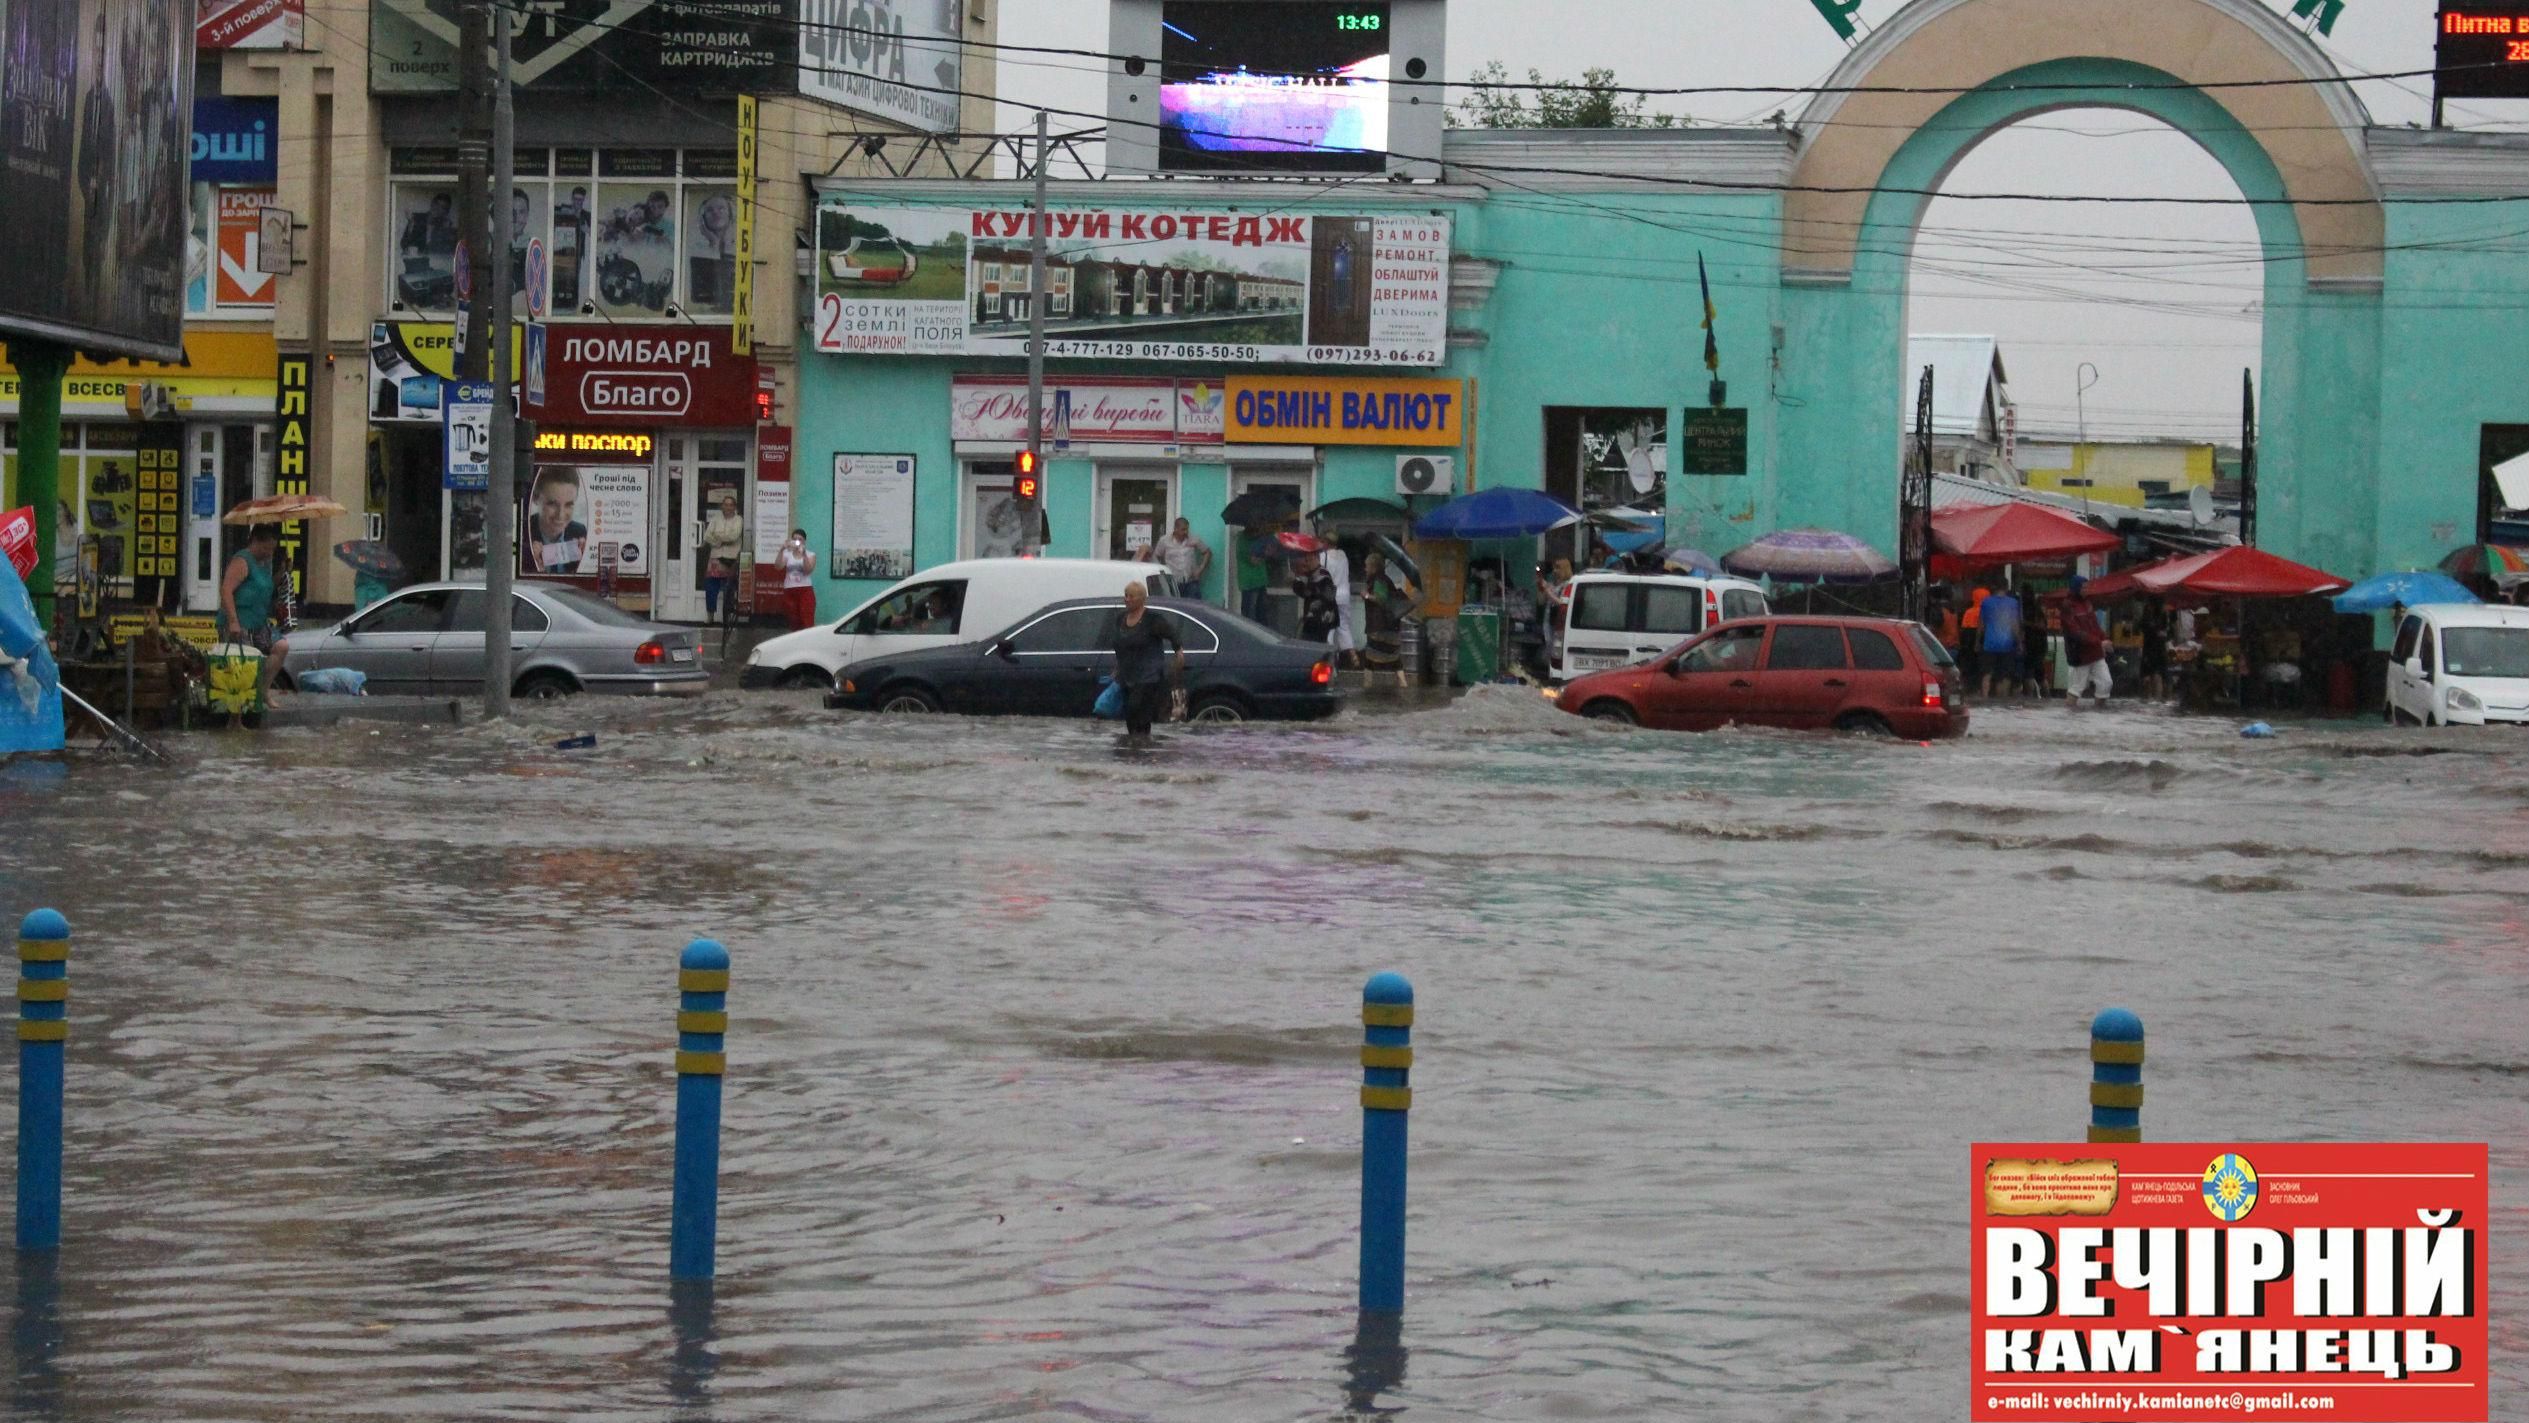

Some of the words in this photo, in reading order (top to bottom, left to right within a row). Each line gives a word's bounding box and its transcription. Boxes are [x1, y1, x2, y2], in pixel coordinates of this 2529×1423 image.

[1336, 15, 1380, 30] 13:43
[2444, 12, 2511, 33] Питна
[661, 32, 751, 47] ЗАПРАВКА
[805, 0, 906, 86] ЦИФРА
[413, 41, 423, 56] 2
[390, 61, 449, 76] поверх
[828, 66, 871, 98] МАГАЗИН
[738, 103, 751, 347] НОУТБУКИ
[972, 208, 1110, 239] КУПУЙ
[1121, 213, 1305, 247] КОТЕДЖ
[1376, 230, 1441, 242] ЗАМОВ
[1374, 267, 1439, 281] ОБЛАШТУЙ
[1373, 289, 1438, 301] ДВЕРИМА
[820, 293, 842, 348] 2
[844, 319, 906, 332] землі
[914, 327, 963, 341] ПОЛЯ
[847, 335, 906, 351] ПОДАРУНОК!
[1023, 342, 1133, 356] 07-4-777-129
[563, 339, 711, 368] ЛОМБАРД
[1307, 348, 1436, 363] (097)293-06-62
[594, 380, 681, 406] Благо
[1236, 389, 1331, 428] ОБМІН
[1342, 391, 1451, 430] ВАЛЮТ
[594, 473, 620, 483] Гроші
[622, 474, 636, 484] під
[590, 484, 615, 492] чесне
[616, 484, 642, 492] слово
[1021, 480, 1035, 496] 12
